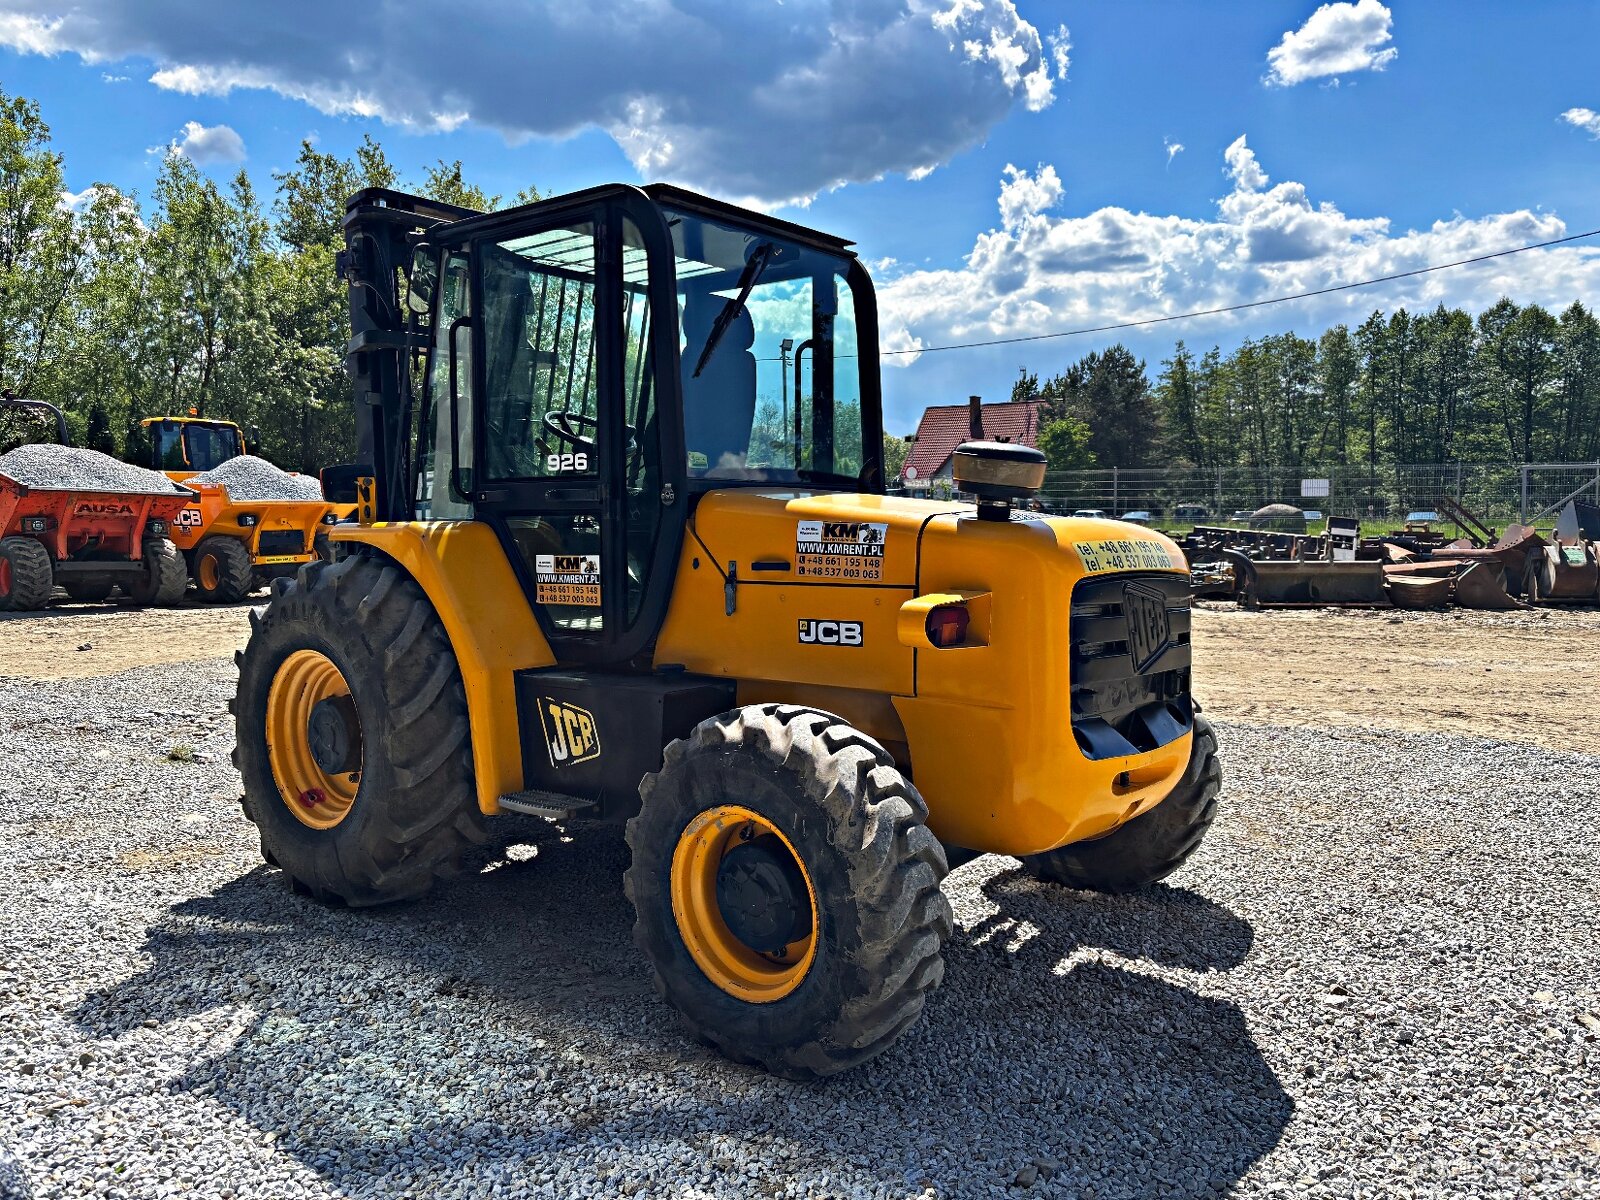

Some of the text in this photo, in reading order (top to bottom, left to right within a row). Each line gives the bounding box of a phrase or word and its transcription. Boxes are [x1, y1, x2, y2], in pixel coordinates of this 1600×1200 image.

[547, 453, 587, 471] 926
[77, 503, 134, 513] AUSA
[173, 510, 202, 525] JCB
[824, 523, 858, 538] KM
[797, 542, 883, 556] WWW.KMRENT.PL
[1077, 541, 1098, 555] tel.
[1099, 541, 1118, 554] +48
[1117, 541, 1136, 554] 661
[1135, 541, 1152, 554] 195
[555, 557, 580, 569] KM
[807, 557, 880, 568] +48 661 195 148
[1085, 556, 1104, 571] tel.
[1105, 555, 1125, 569] +48
[1125, 555, 1141, 568] 537
[1142, 555, 1158, 568] 003
[537, 574, 600, 584] WWW.KMRENT.PL
[807, 567, 880, 579] +48 537 003 063
[572, 586, 584, 594] 195
[586, 586, 598, 594] 148
[558, 595, 570, 603] 537
[571, 595, 584, 603] 003
[585, 596, 598, 604] 063
[799, 621, 862, 645] JCB
[548, 703, 594, 760] JCB
